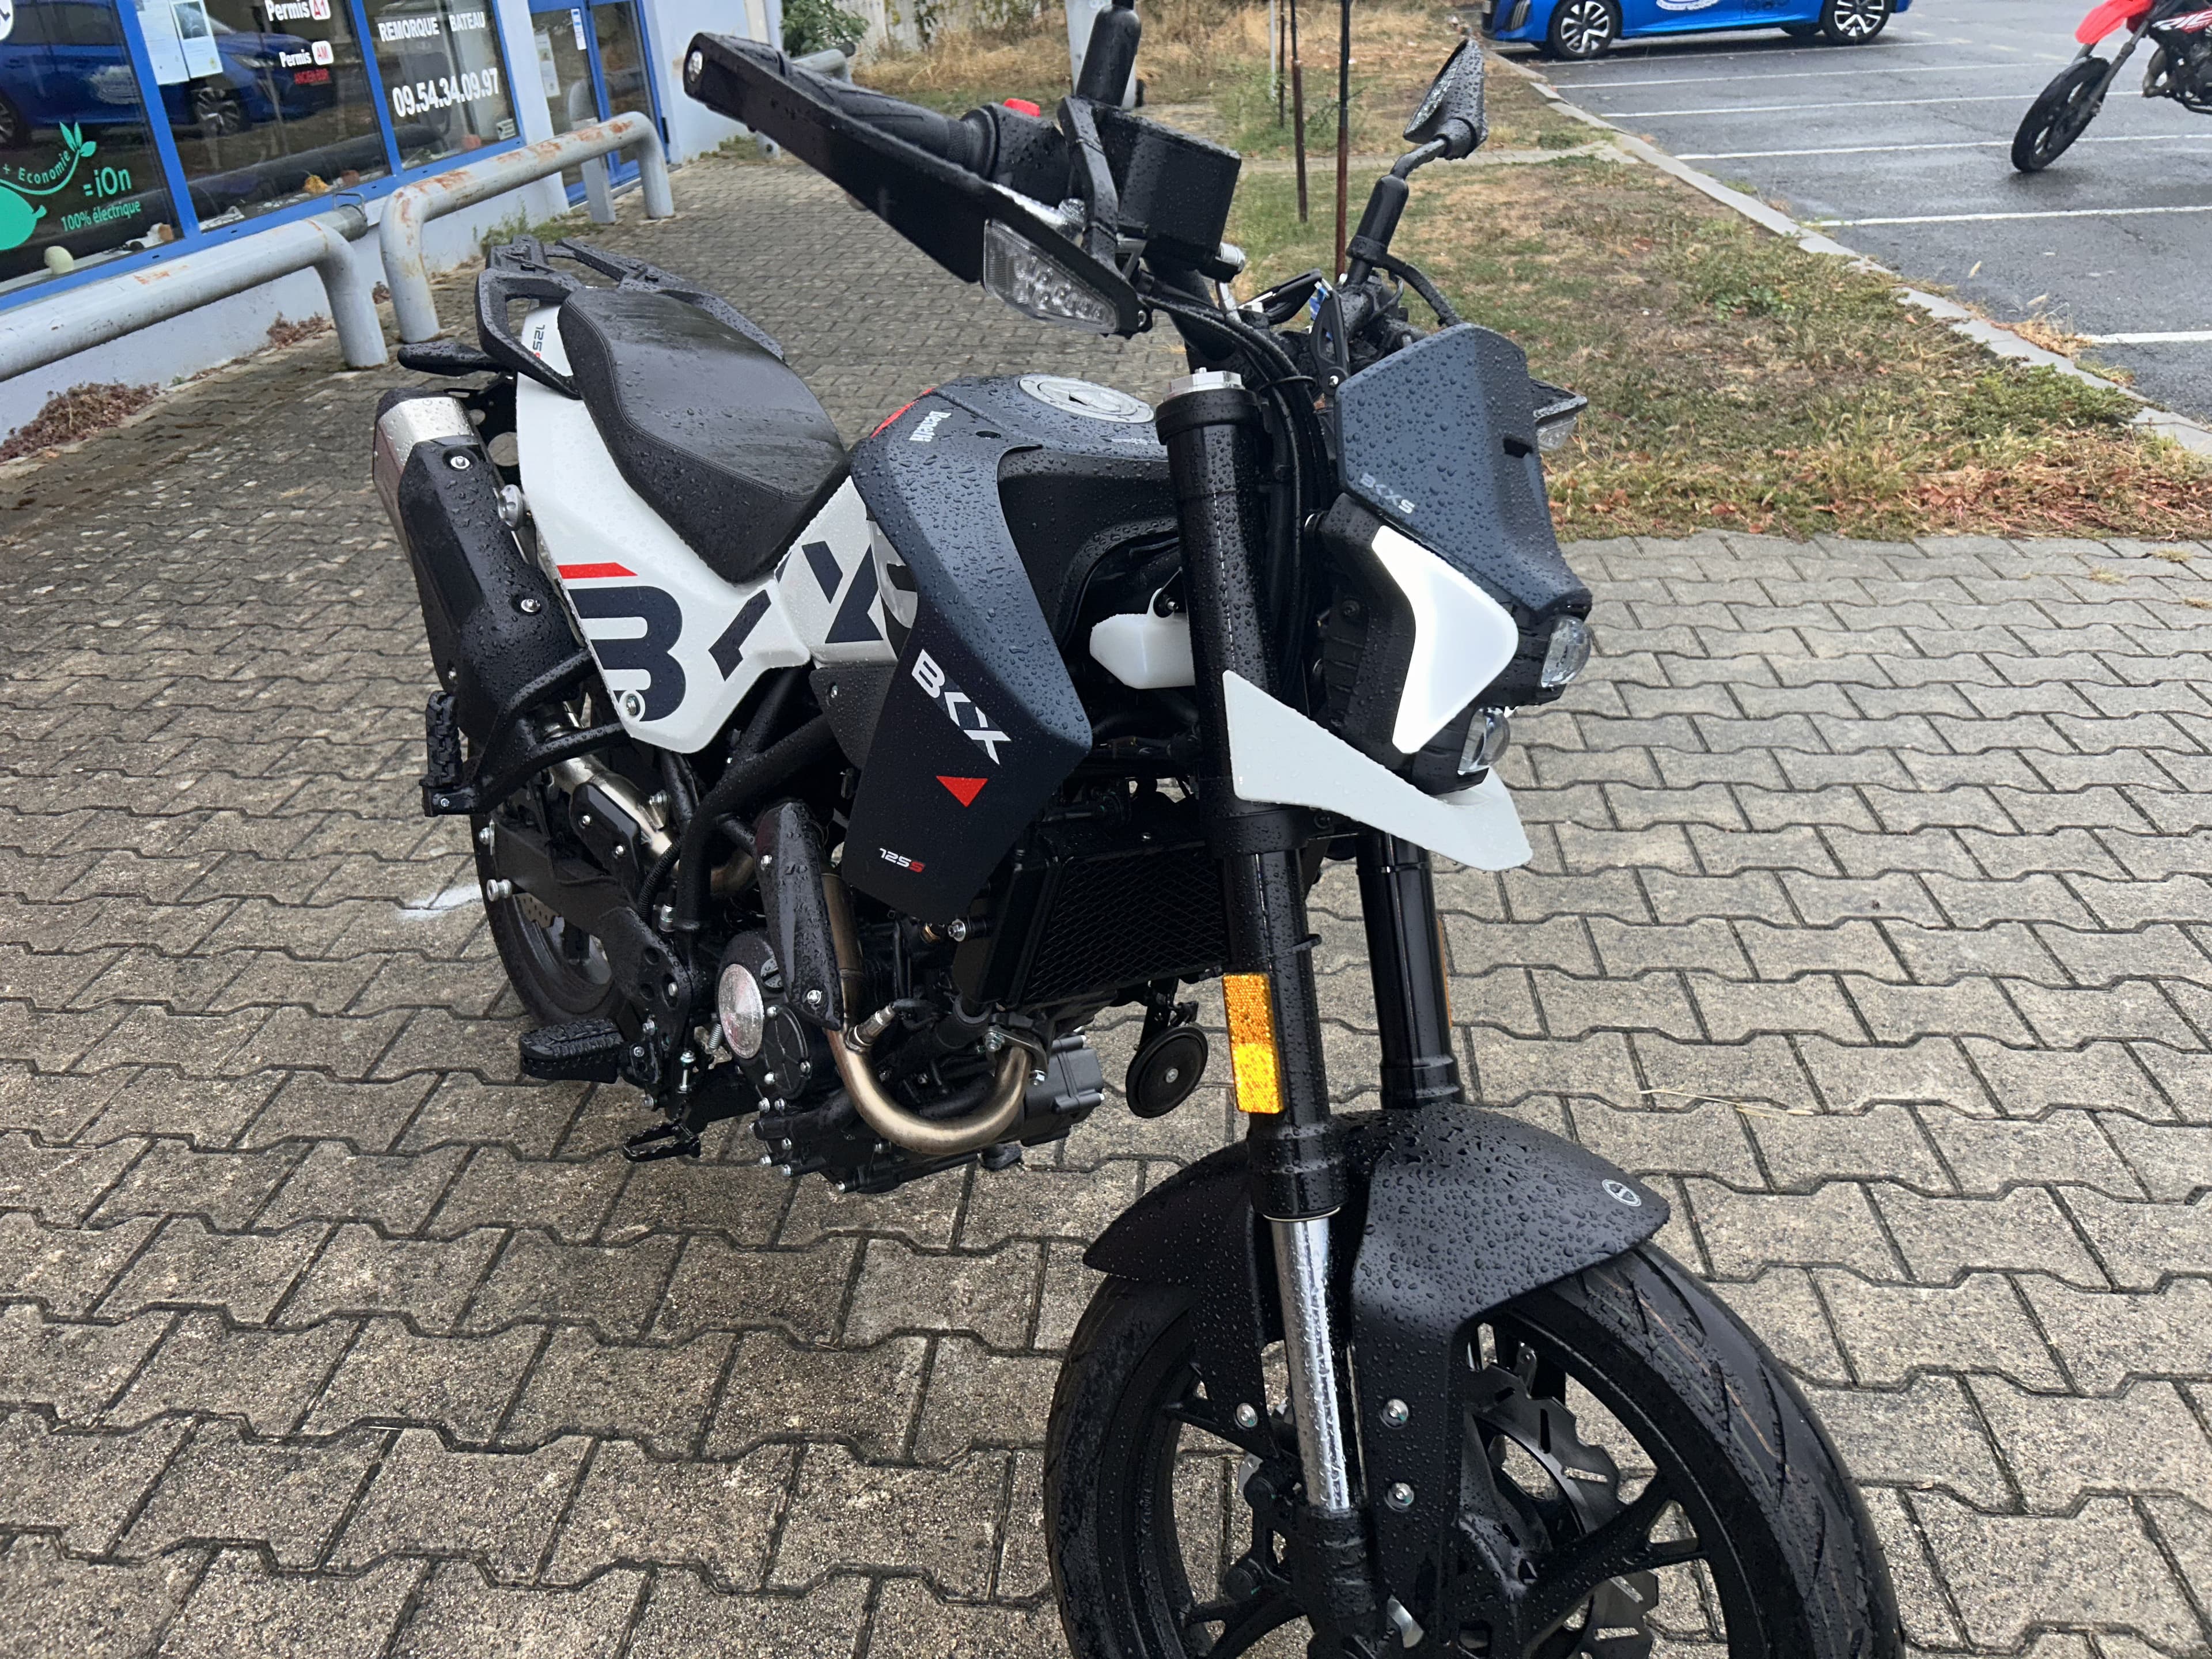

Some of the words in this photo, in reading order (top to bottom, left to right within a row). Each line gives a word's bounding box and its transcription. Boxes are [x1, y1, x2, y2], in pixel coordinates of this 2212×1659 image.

[264, 0, 310, 21] Permis
[378, 17, 440, 42] REMORQUE
[449, 12, 486, 32] BATEAU
[279, 48, 312, 68] Permis
[392, 67, 499, 118] 09.54.34.09.97
[18, 150, 71, 184] Economie
[60, 211, 92, 232] 100%
[92, 200, 142, 225] électrique
